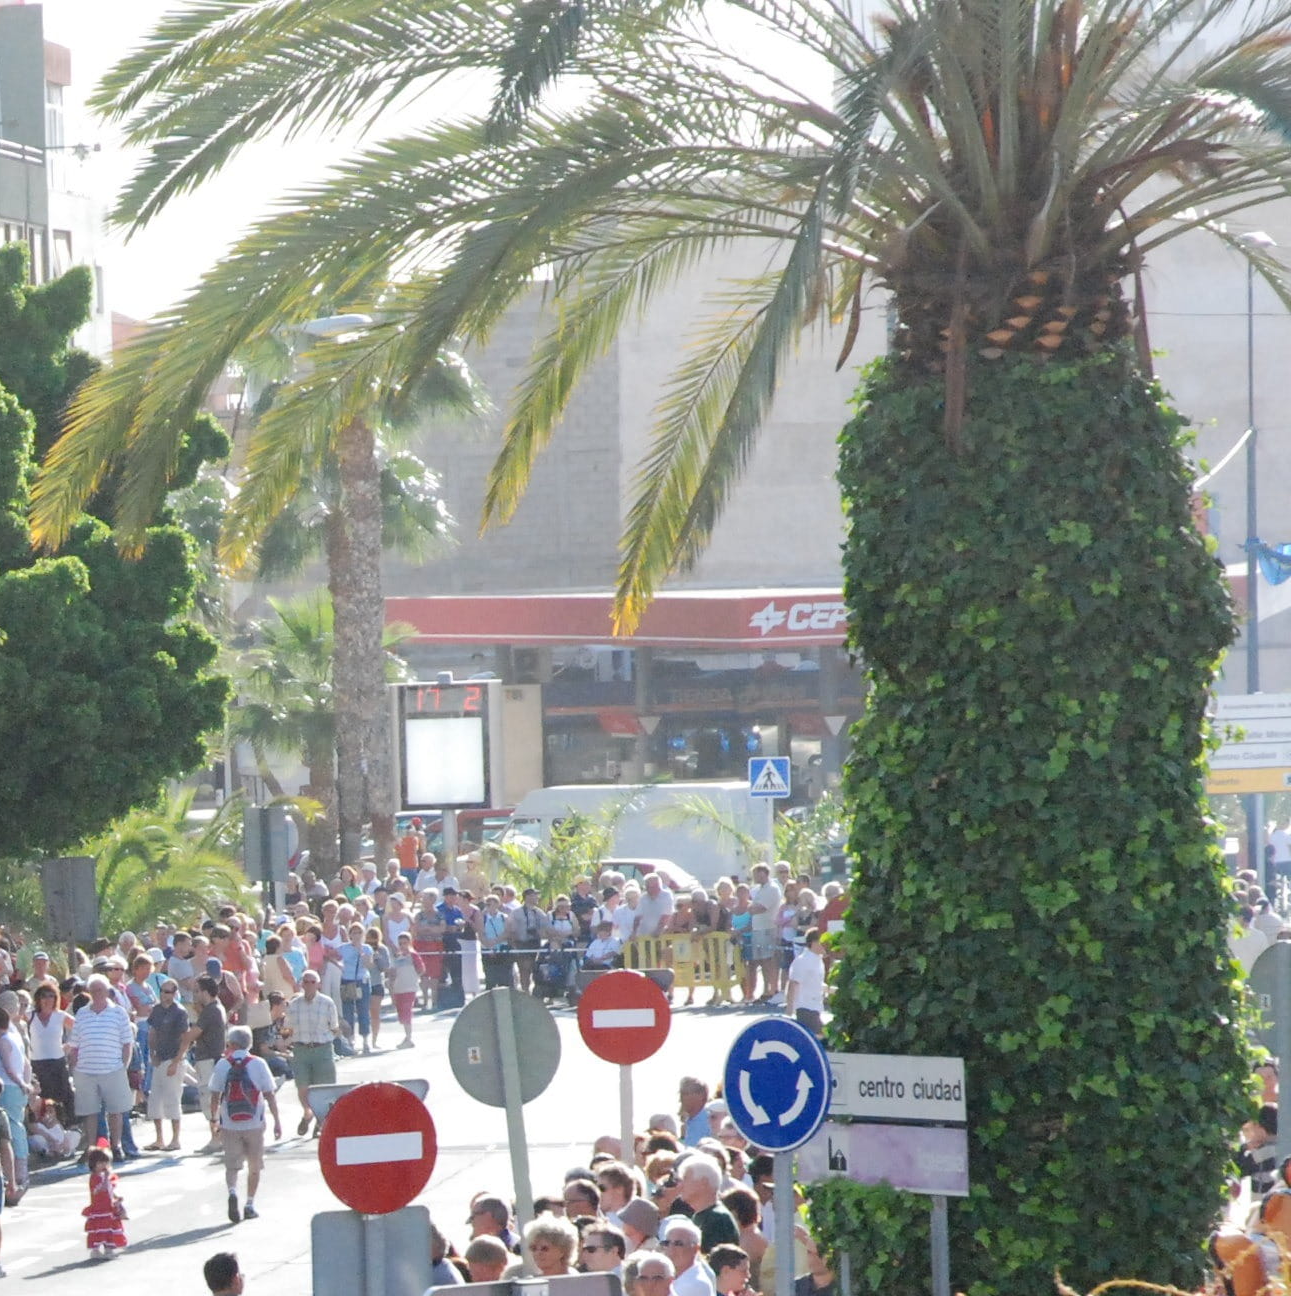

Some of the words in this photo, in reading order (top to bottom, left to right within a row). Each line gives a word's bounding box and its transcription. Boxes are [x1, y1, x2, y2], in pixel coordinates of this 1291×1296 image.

[787, 602, 848, 631] CEP
[858, 1075, 905, 1098] centro
[912, 1077, 963, 1102] ciudad
